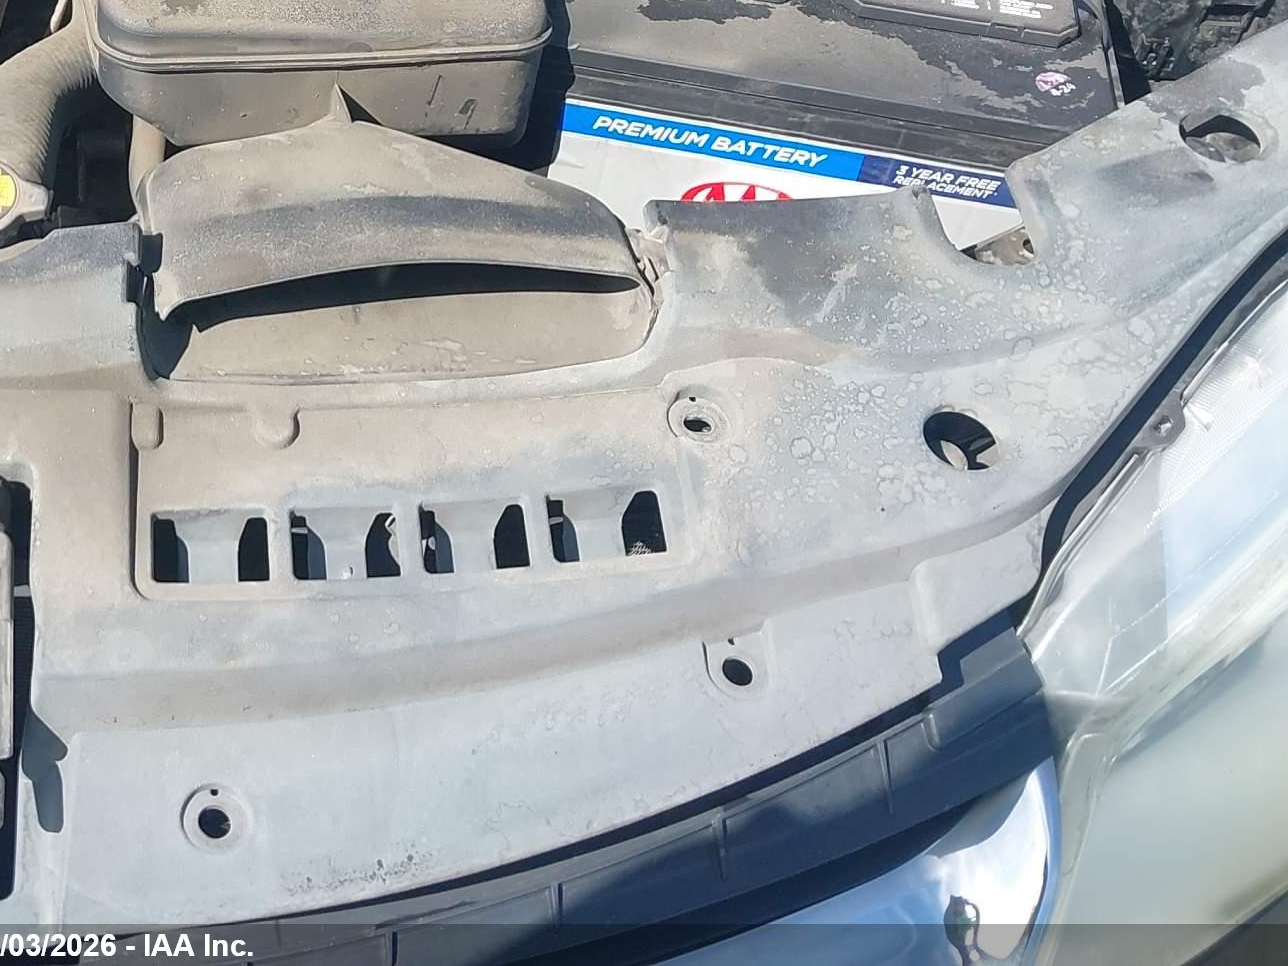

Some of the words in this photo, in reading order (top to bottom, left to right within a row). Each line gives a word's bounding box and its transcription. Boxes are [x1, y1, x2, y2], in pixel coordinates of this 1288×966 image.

[593, 115, 710, 148] PREMIUM
[711, 136, 828, 168] BATTERY
[895, 164, 907, 176] 3
[910, 167, 955, 184] YEAR
[955, 176, 1002, 191] FREE
